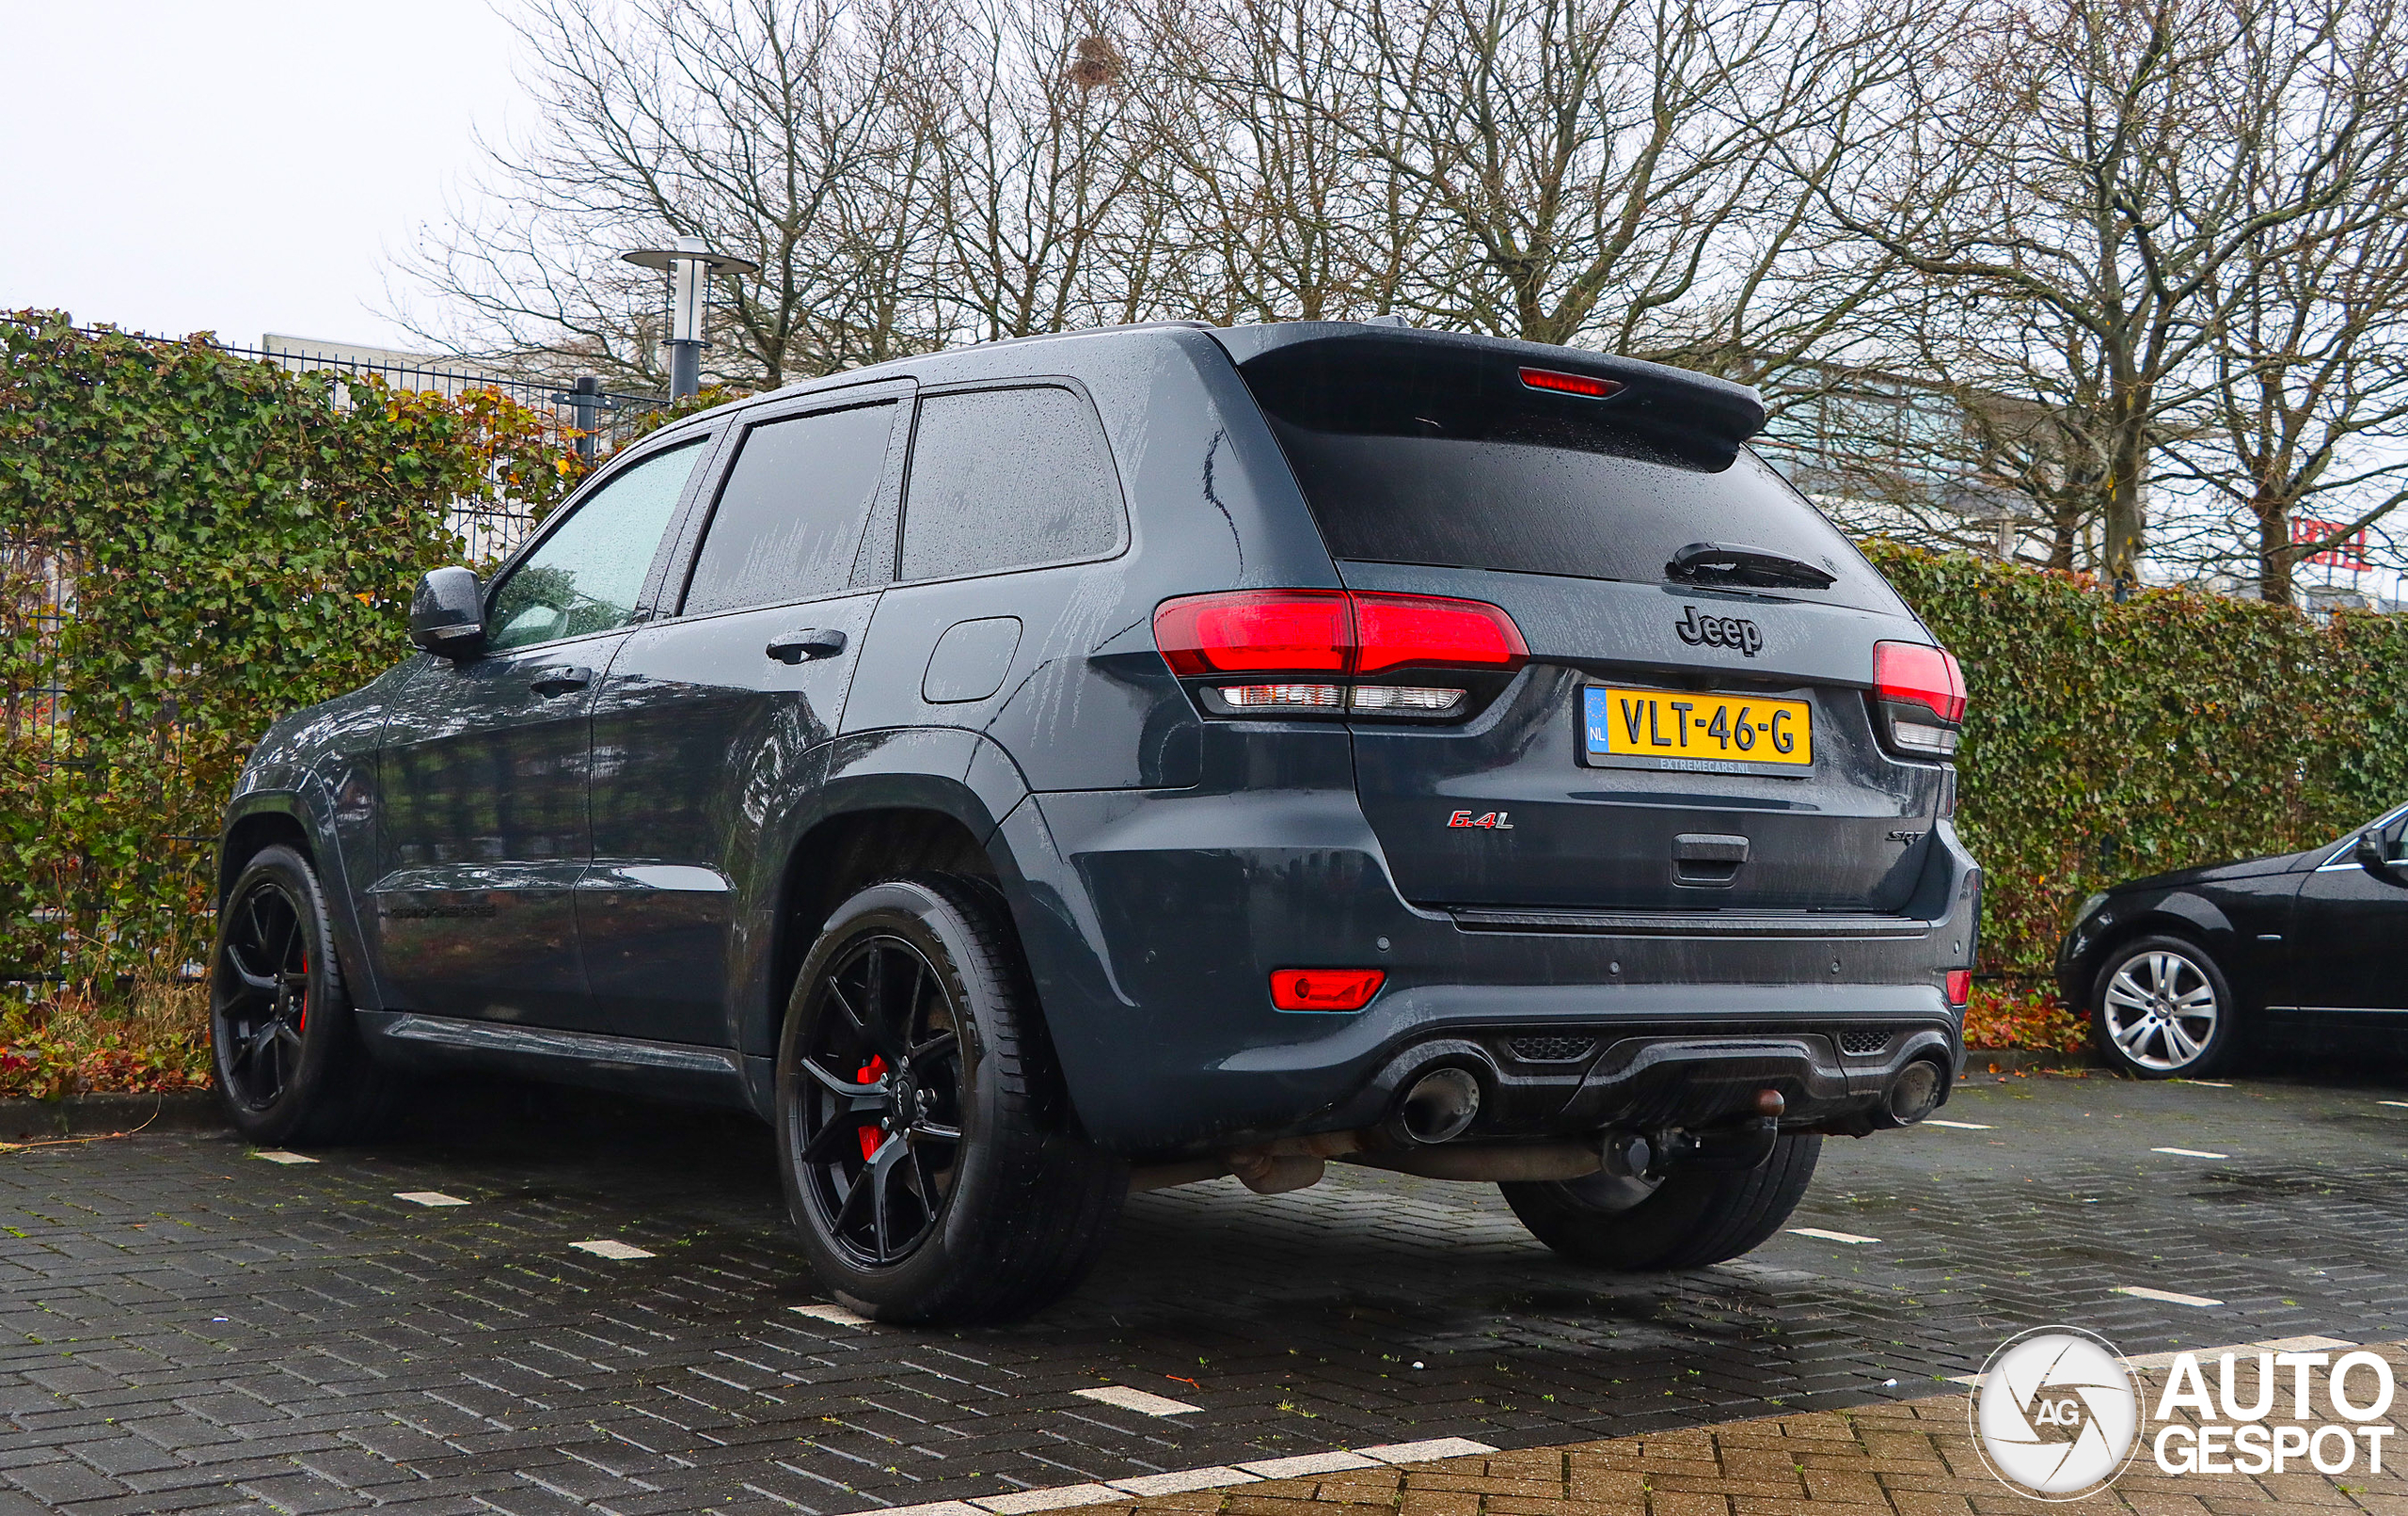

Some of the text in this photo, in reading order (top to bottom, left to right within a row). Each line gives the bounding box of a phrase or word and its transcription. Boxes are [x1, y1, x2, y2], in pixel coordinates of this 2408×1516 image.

[1675, 606, 1763, 657] Jeep
[1590, 726, 1607, 741] NL
[1620, 698, 1795, 754] VLT-46-G
[1660, 758, 1751, 774] EXTREMECARS.NL
[1447, 810, 1514, 829] 6.4L
[1884, 830, 1926, 847] SRT
